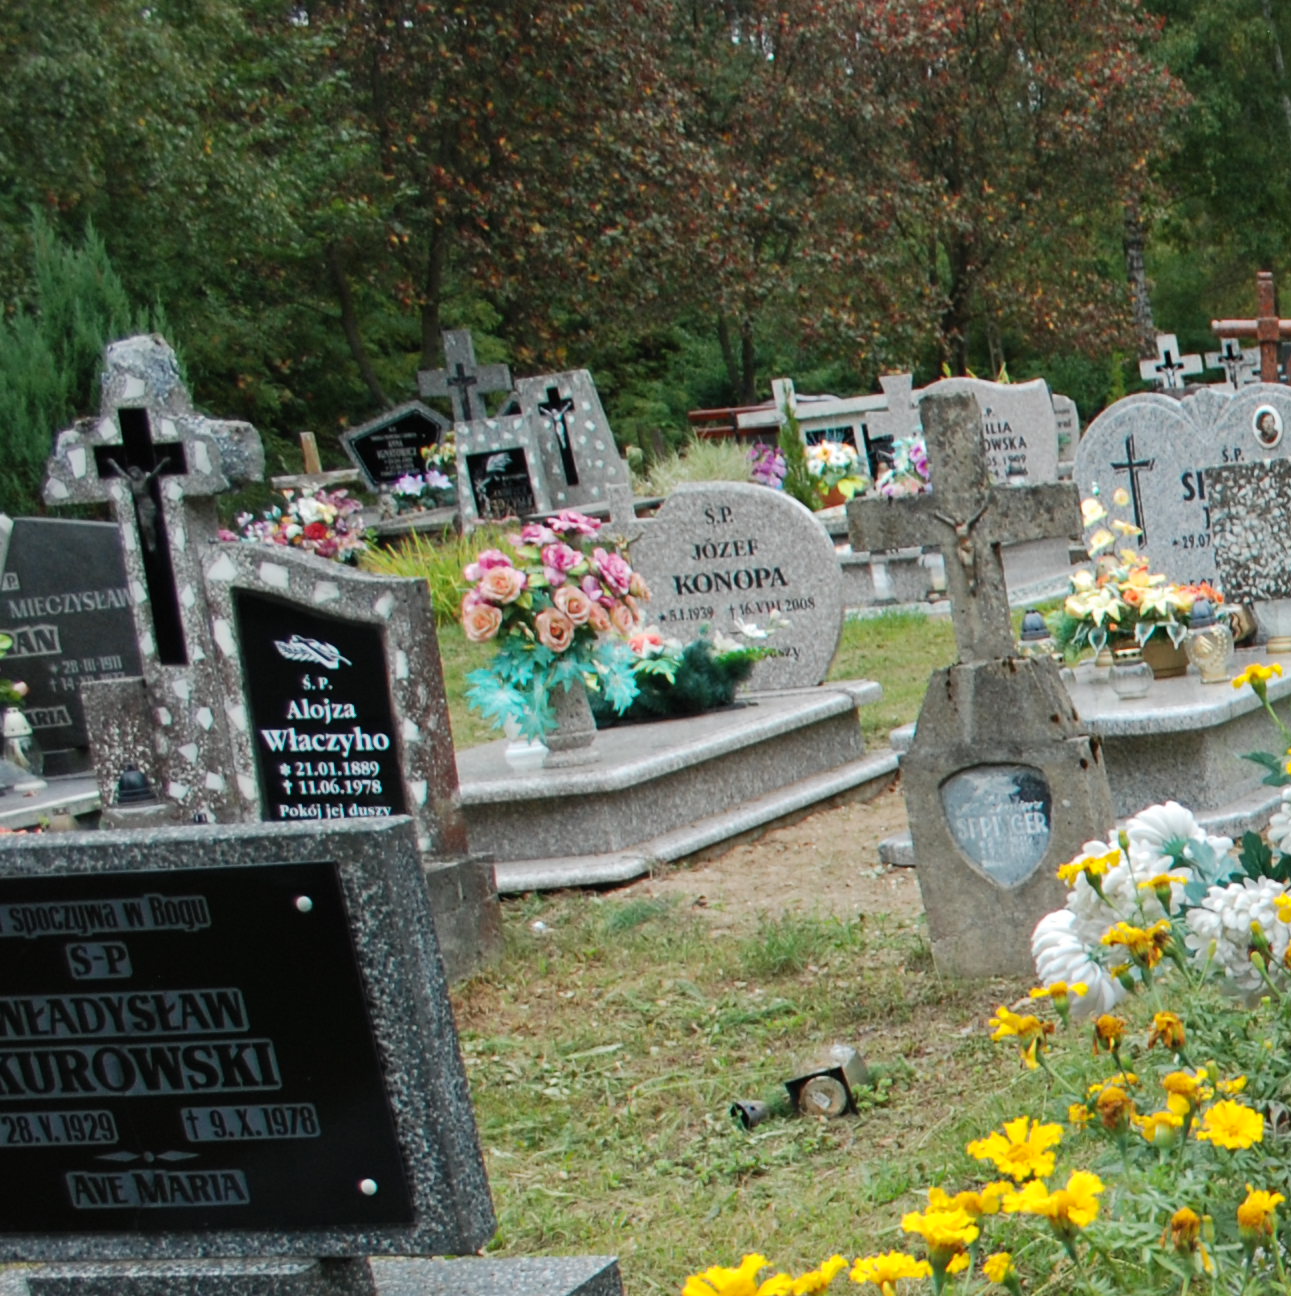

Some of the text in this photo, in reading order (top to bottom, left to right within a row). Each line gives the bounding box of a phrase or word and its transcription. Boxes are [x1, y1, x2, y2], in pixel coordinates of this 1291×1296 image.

[691, 537, 759, 562] JÓZEF
[672, 566, 790, 596] KONOPA
[286, 698, 358, 725] Alojza
[260, 726, 391, 758] Właczyho
[294, 760, 381, 777] 21.01.1889
[298, 779, 384, 796] 11.06.1978
[12, 897, 209, 935] spoczywa w Bogu
